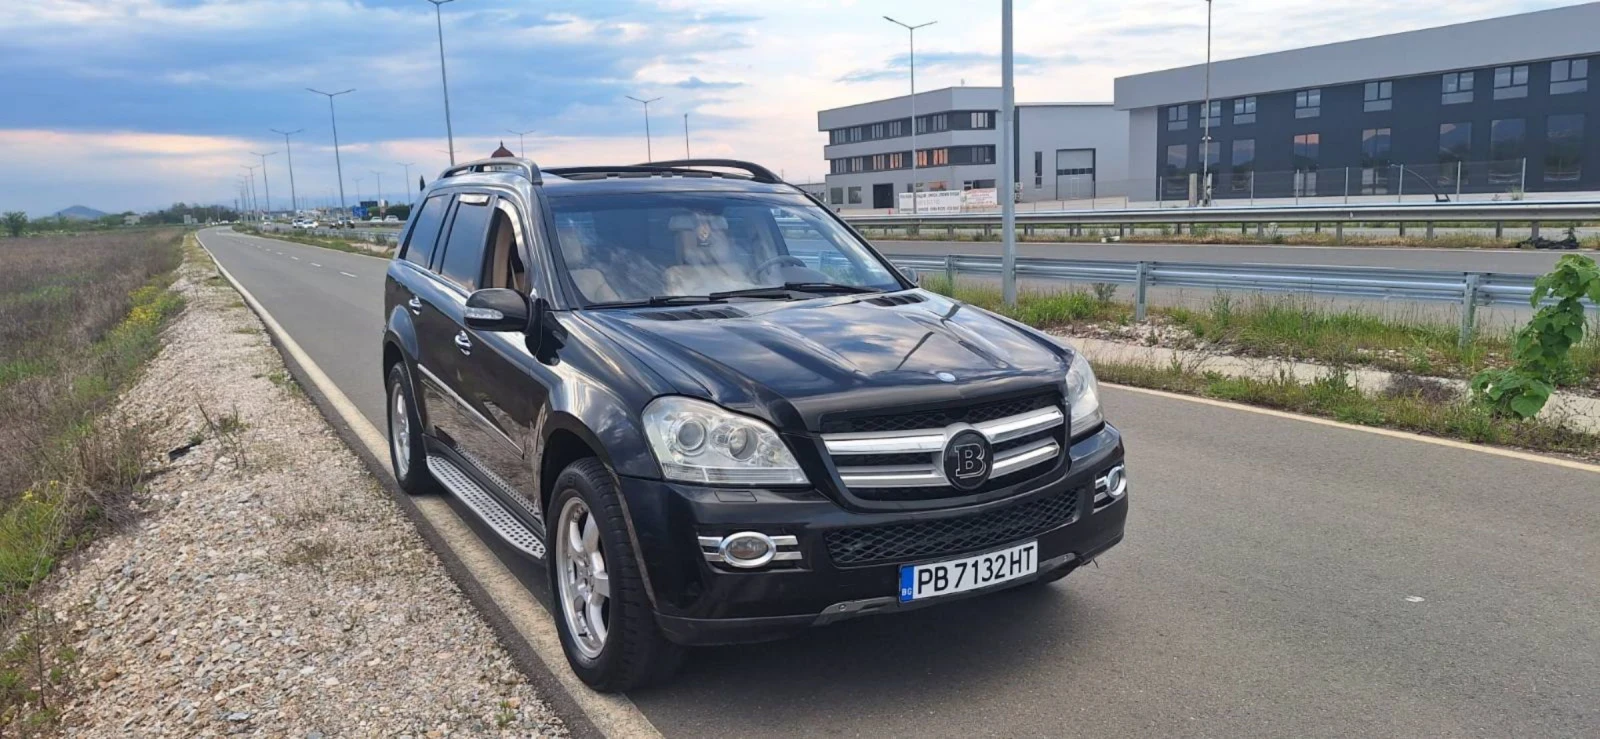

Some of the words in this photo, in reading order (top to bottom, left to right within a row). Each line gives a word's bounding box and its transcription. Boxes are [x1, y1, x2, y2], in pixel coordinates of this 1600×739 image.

[954, 443, 987, 479] B
[917, 566, 949, 595] PB
[954, 554, 1006, 589] 7132
[1009, 545, 1035, 576] HT
[901, 588, 913, 597] BG
